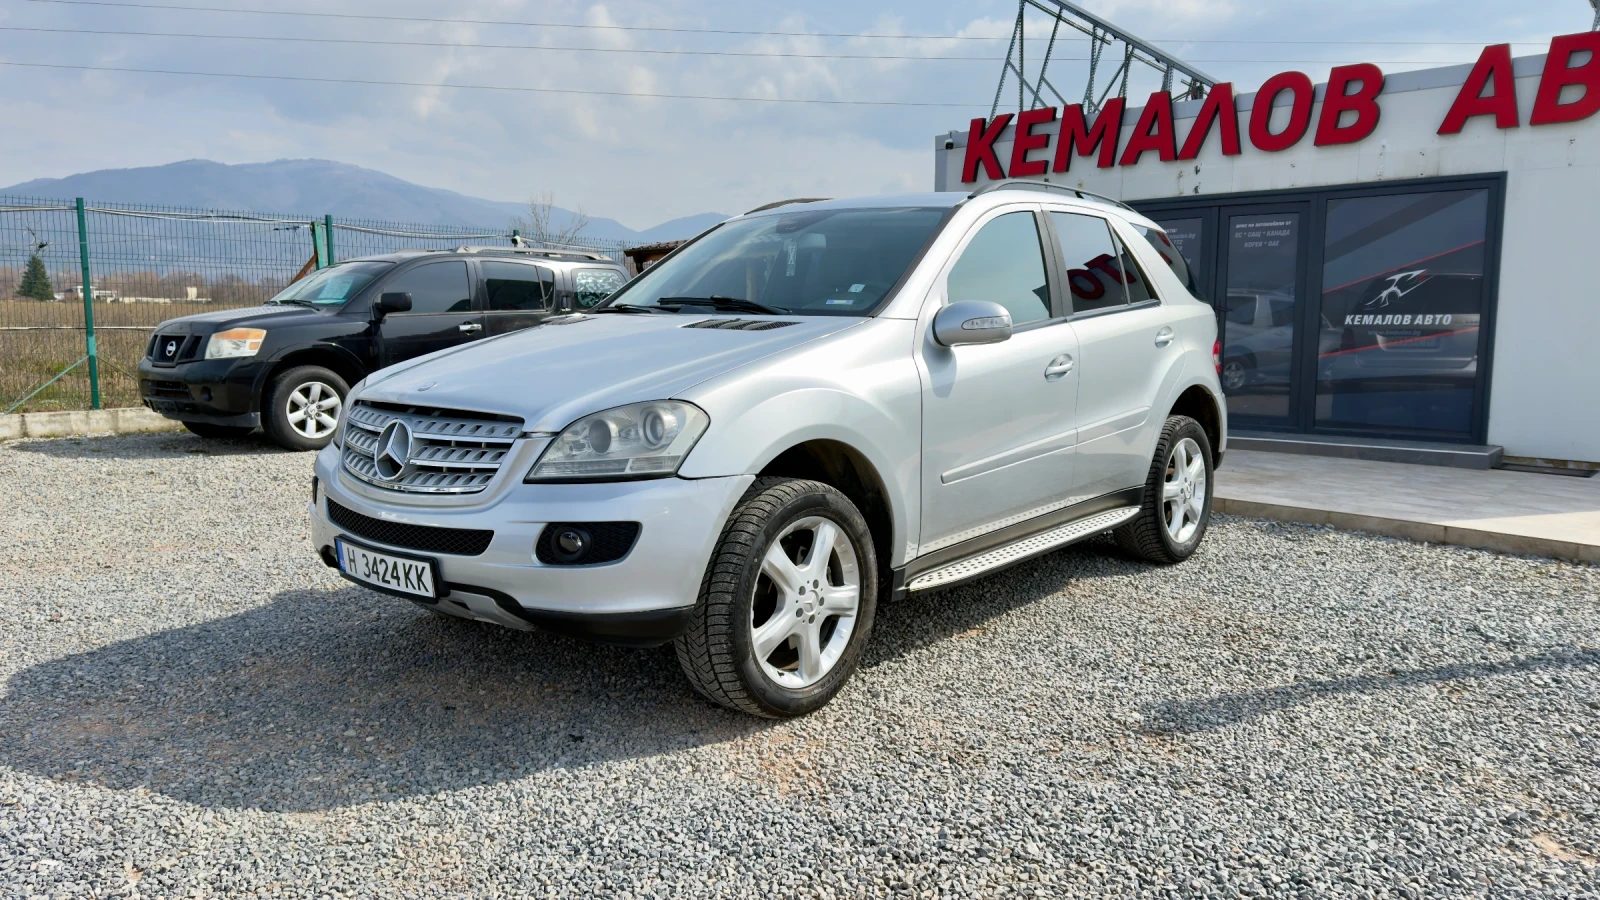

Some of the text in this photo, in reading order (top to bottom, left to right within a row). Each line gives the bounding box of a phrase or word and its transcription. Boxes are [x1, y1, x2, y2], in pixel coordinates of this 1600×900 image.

[961, 62, 1386, 184] КЕМАЛОВ
[1344, 314, 1452, 325] КЕМАЛОВ АВТО
